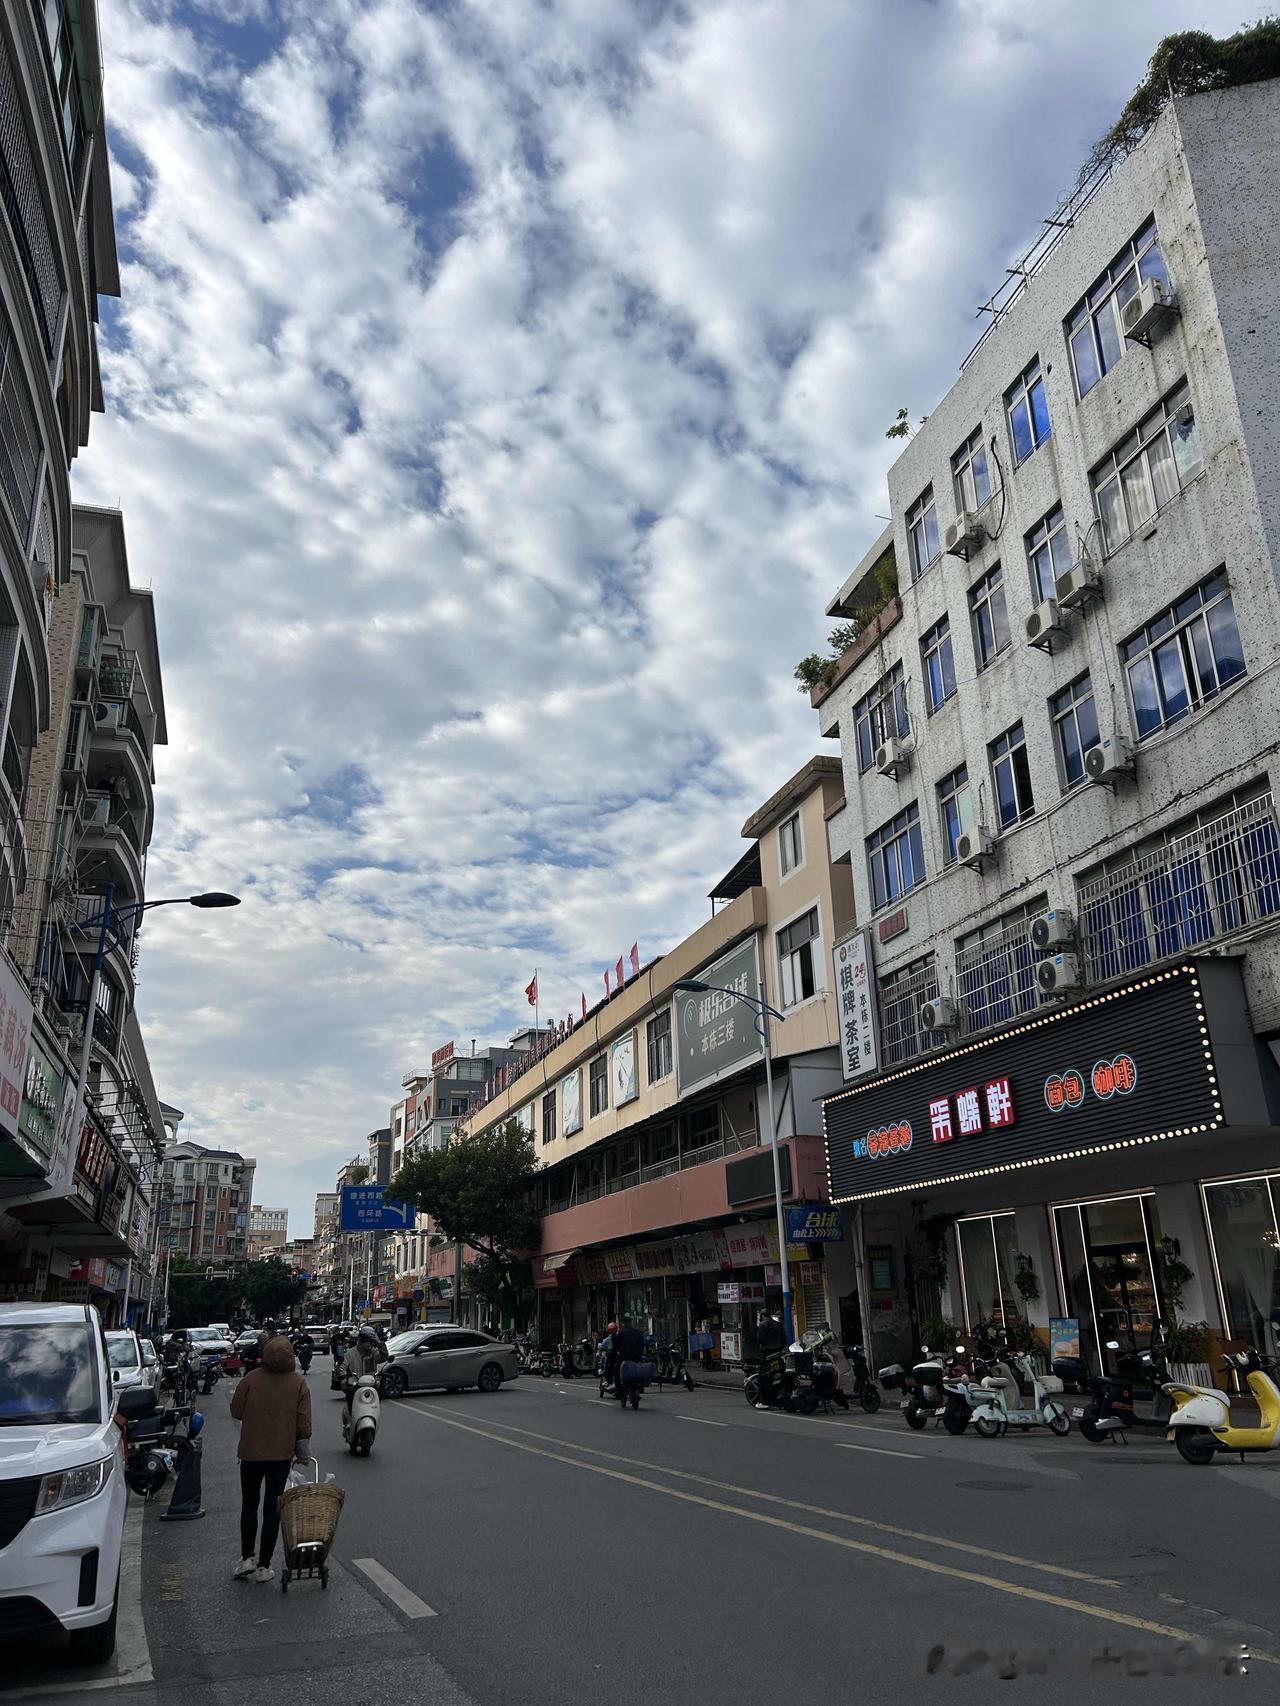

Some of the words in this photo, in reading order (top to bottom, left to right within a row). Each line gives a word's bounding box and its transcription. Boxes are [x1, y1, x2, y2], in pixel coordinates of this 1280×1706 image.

[698, 971, 748, 1028] 极乐台球
[839, 963, 861, 1073] 棋牌茶室
[700, 1019, 735, 1056] 本栋三楼
[859, 993, 872, 1056] 本栋二楼
[1046, 1075, 1082, 1109] 面包
[1092, 1056, 1135, 1097] 咖啡
[358, 1209, 382, 1218] 西环路
[793, 1228, 815, 1238] 由此上
[805, 1211, 838, 1228] 台球
